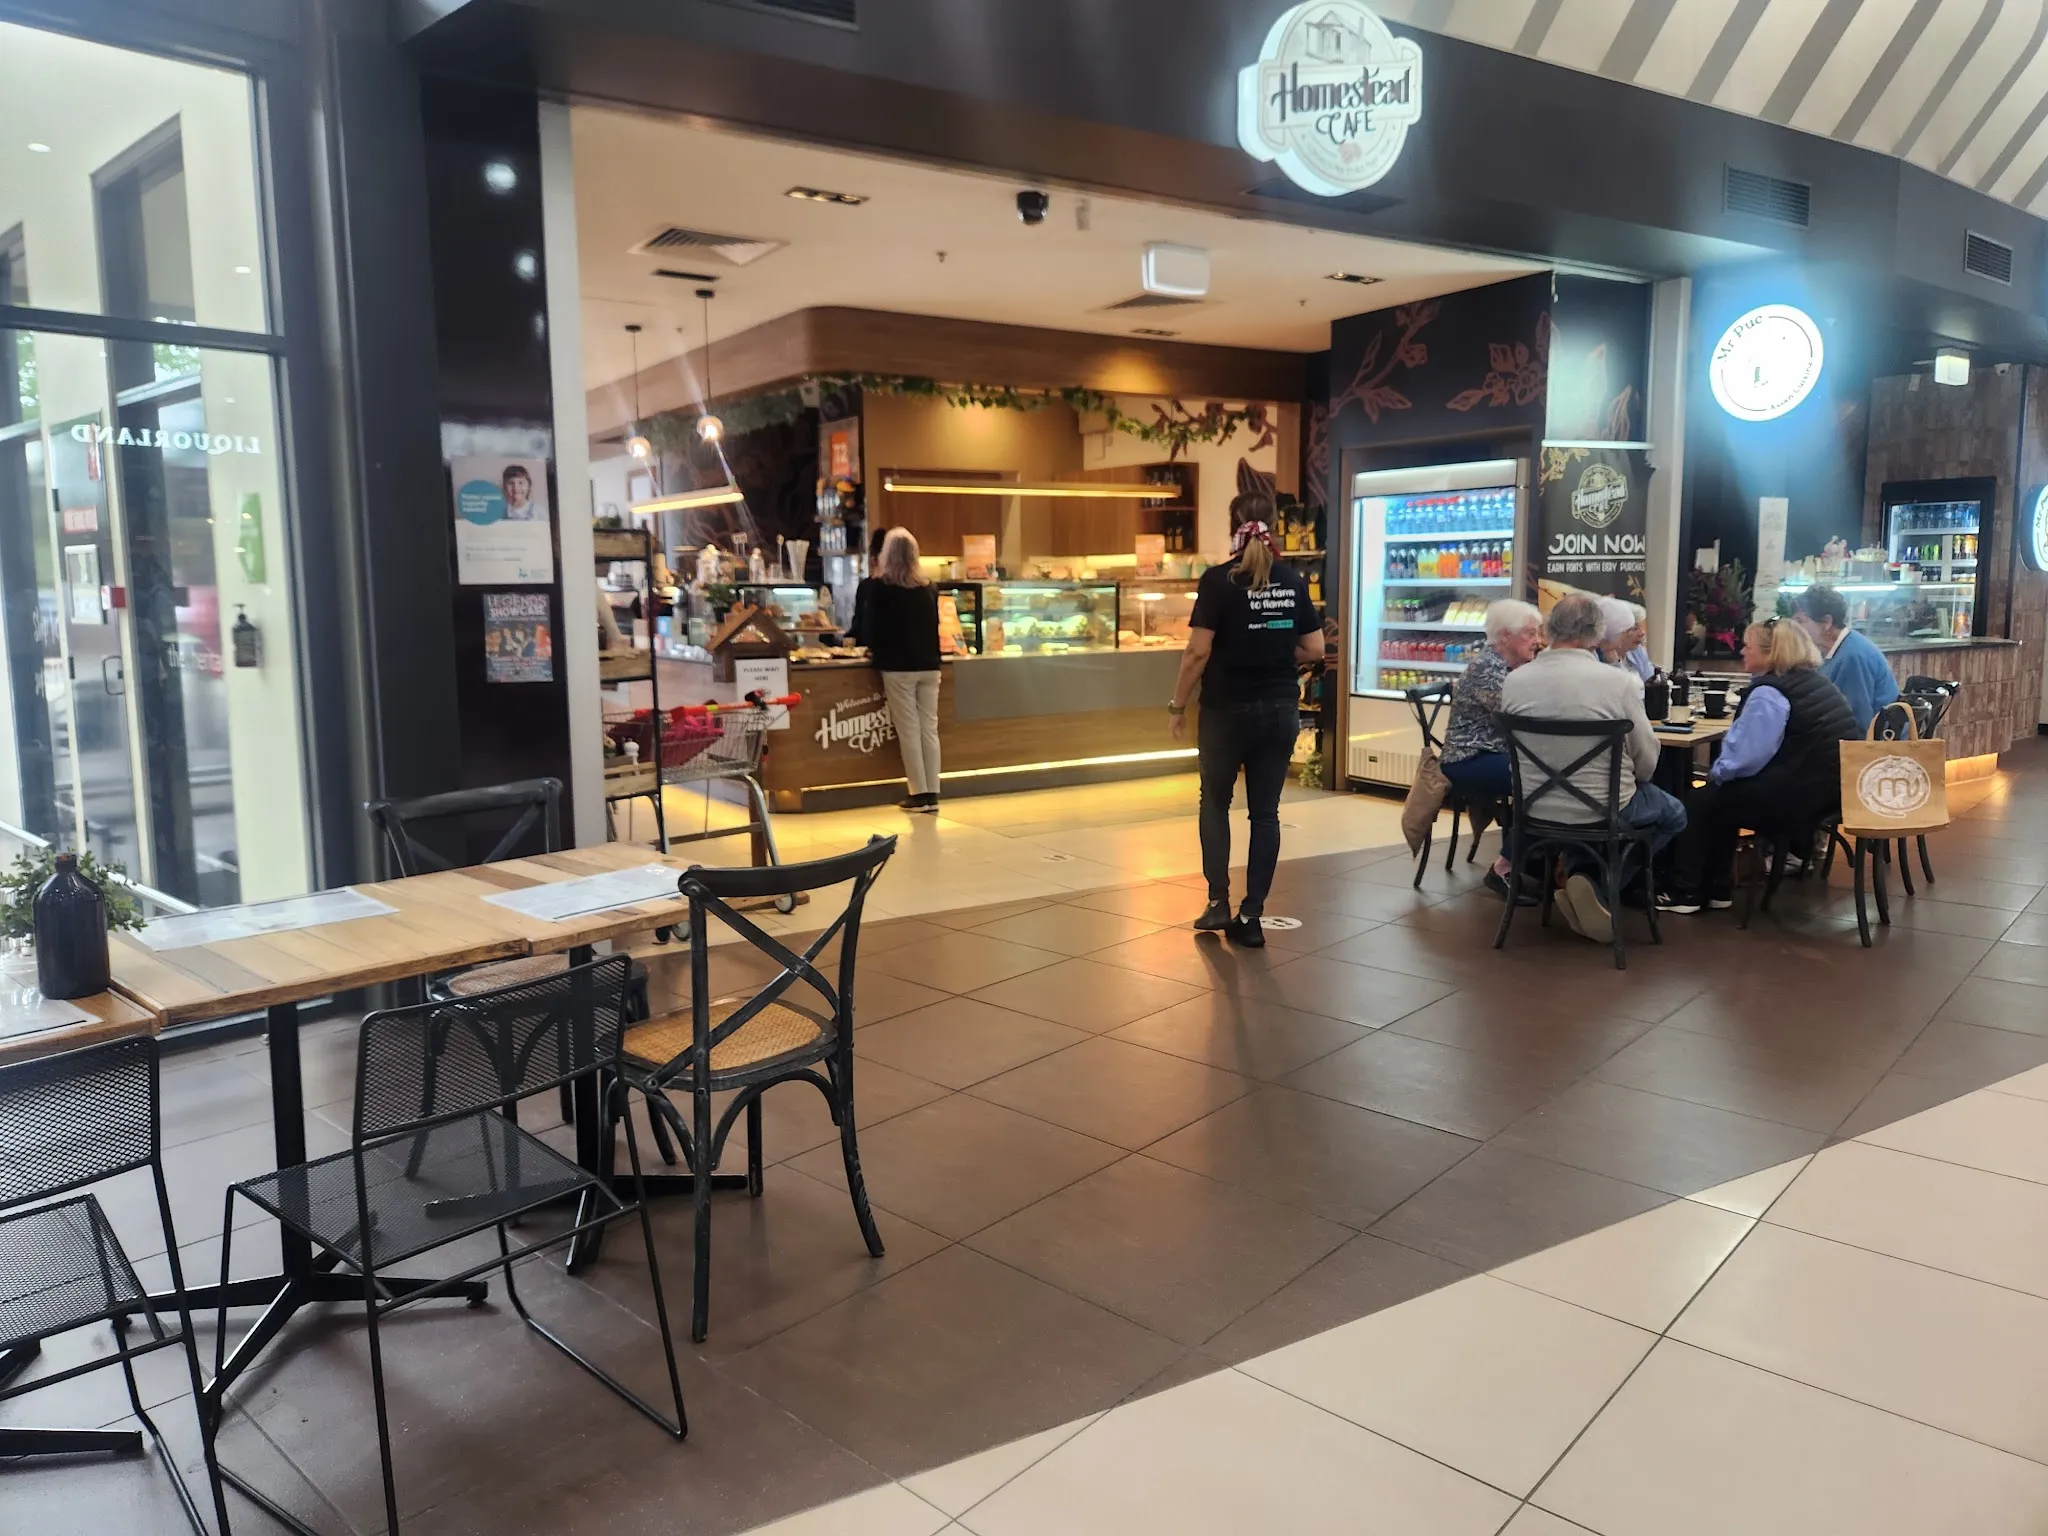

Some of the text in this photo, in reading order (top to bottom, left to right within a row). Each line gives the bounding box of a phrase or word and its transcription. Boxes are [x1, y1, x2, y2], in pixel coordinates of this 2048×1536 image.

[1271, 61, 1411, 123] Homestead
[1315, 109, 1376, 145] CAFE
[1717, 339, 1735, 360] Mr
[1548, 534, 1645, 554] JOIN NOW
[487, 594, 547, 607] LEGENDS
[1272, 587, 1296, 598] farm
[490, 606, 546, 618] SHOWCASE
[1250, 599, 1296, 610] to flames
[848, 727, 896, 753] CAFE
